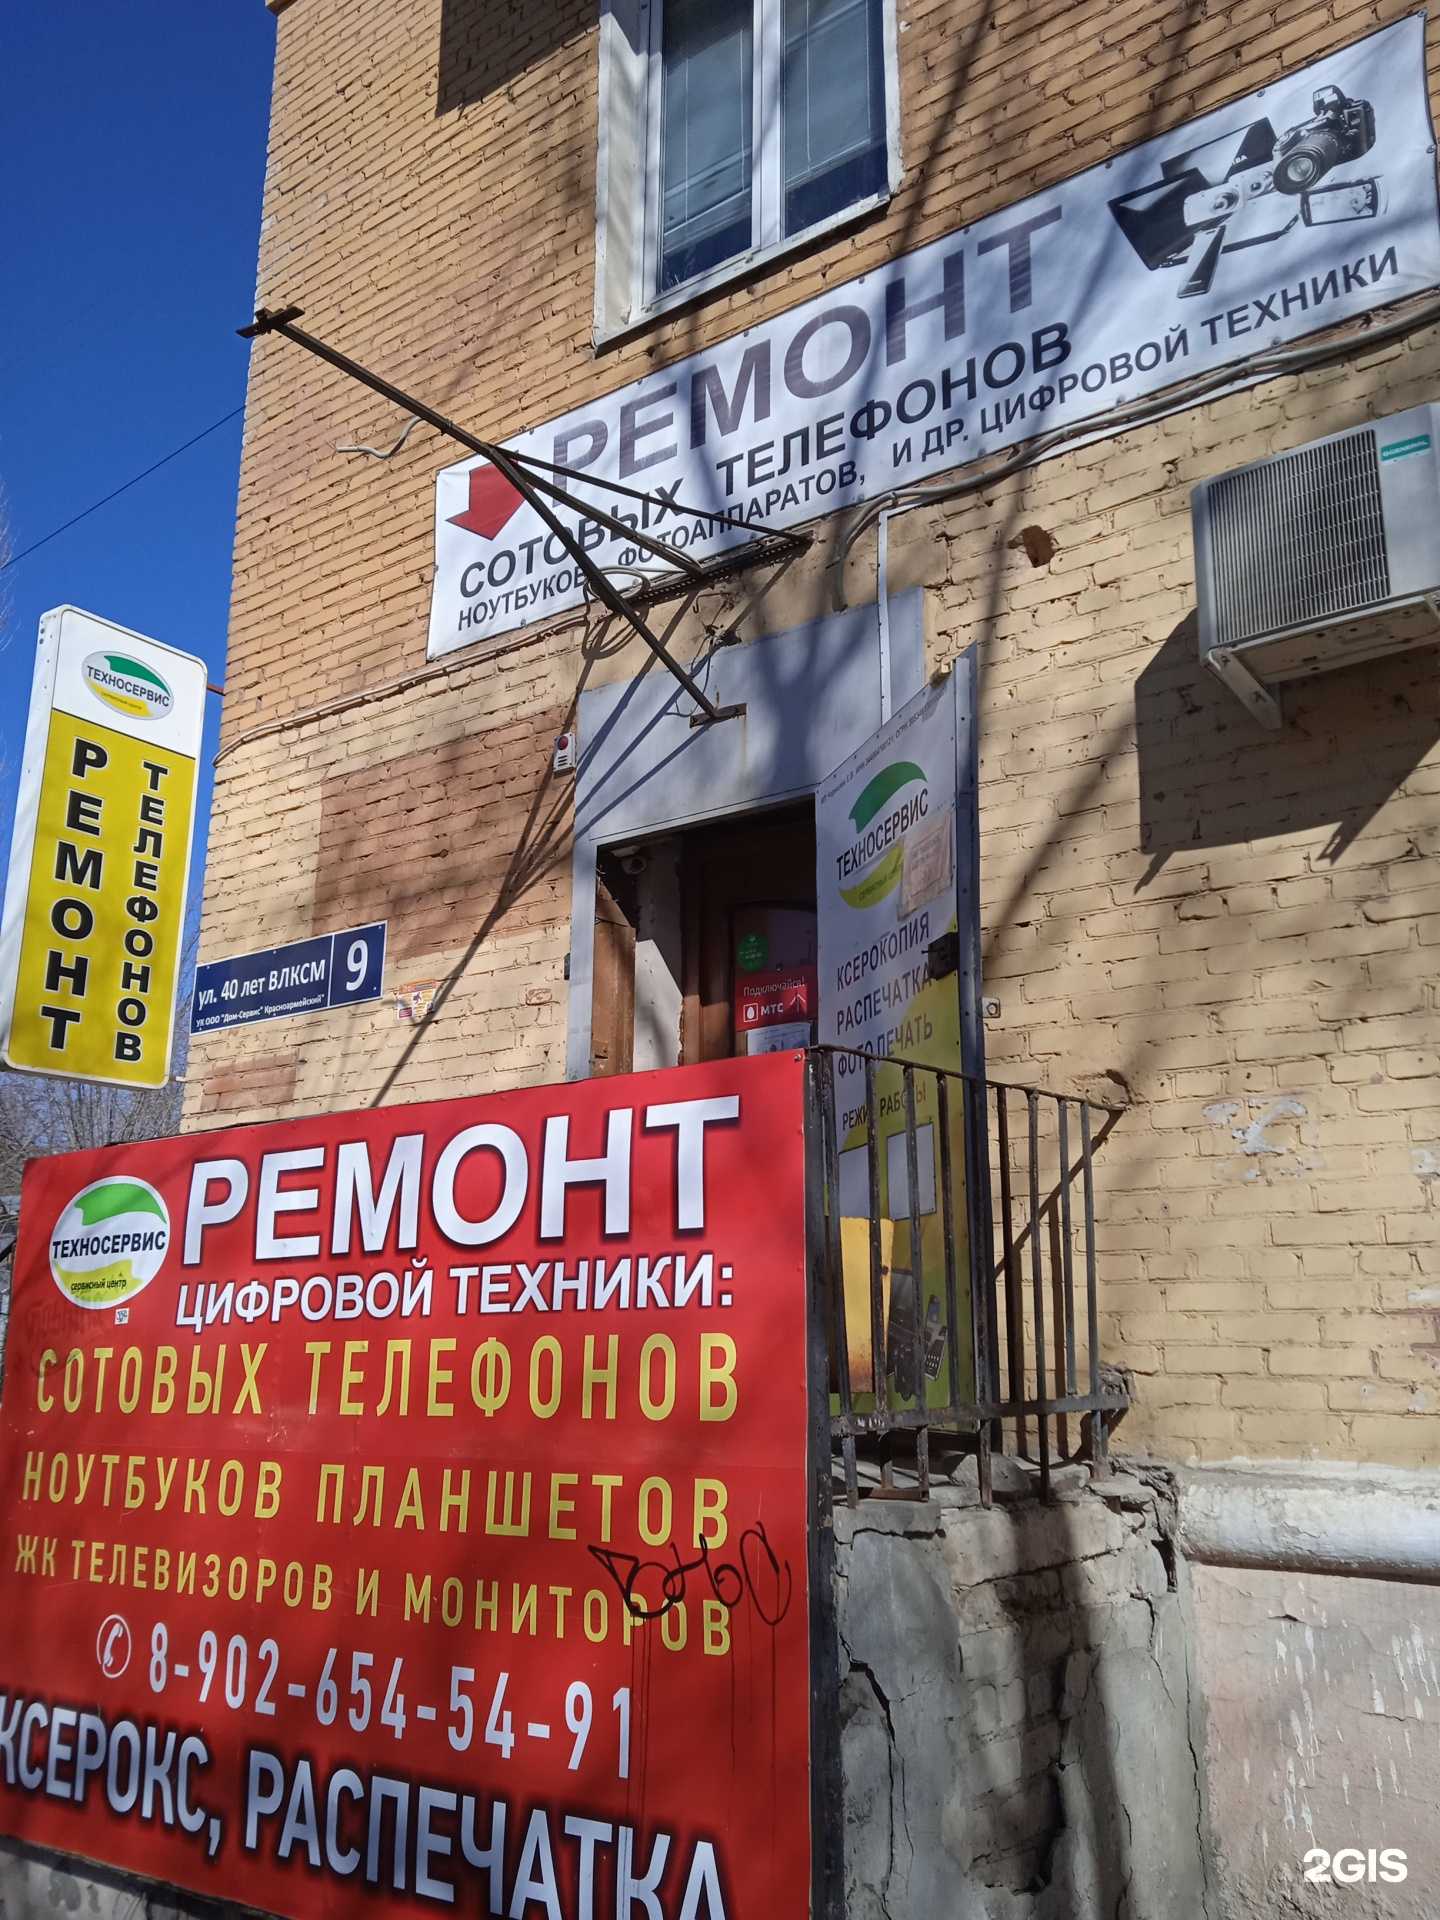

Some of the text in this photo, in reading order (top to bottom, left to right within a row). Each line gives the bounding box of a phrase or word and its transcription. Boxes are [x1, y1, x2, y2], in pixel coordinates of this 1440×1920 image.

[552, 205, 1062, 508] РЕМОНТ
[893, 438, 911, 467] И
[921, 417, 968, 462] ДР.
[980, 324, 1189, 435] ЦИФРОВОЙ
[1201, 247, 1398, 346] ТЕХНИКИ
[460, 321, 1072, 598] СОТОВЫХ ТЕЛЕФОНОВ
[87, 665, 170, 707] ТЕХНОСЕРВИС
[836, 788, 928, 881] ТЕХНОСЕРВИС
[41, 736, 108, 1050] РЕМОНТ
[114, 760, 168, 1063] ТЕЛЕФОНОВ
[199, 959, 326, 1011] ул. 40 лет ВЛКСМ
[346, 938, 369, 992] 9
[837, 911, 929, 992] КСЕРОКОПИЯ
[205, 1016, 220, 1026] ООО
[760, 1002, 784, 1016] МТС
[837, 961, 932, 1035] РАСПЕЧАТКА
[877, 1013, 932, 1057] ПЕЧАТЬ
[182, 1094, 740, 1266] РЕМОНТ
[52, 1230, 166, 1259] ТЕХНОСЕРВИС
[71, 1278, 127, 1294] сервисный центр
[176, 1253, 734, 1333] ЦИФРОВОЙ ТЕХНИКИ:
[37, 1332, 739, 1422] СОТОВЫХ ТЕЛЕФОНОВ
[22, 1451, 728, 1549] НОУТБУКОВ ПЛАНШЕТОВ
[15, 1534, 58, 1577] ЖК
[72, 1540, 333, 1611] ТЕЛЕВИЗОРОВ
[356, 1567, 379, 1617] И
[404, 1572, 731, 1657] МОНИТОРОВ
[150, 1621, 631, 1779] 8-902-654-54-91
[0, 1695, 727, 1920] КСЕРОКС, РАСПЕЧАТКА
